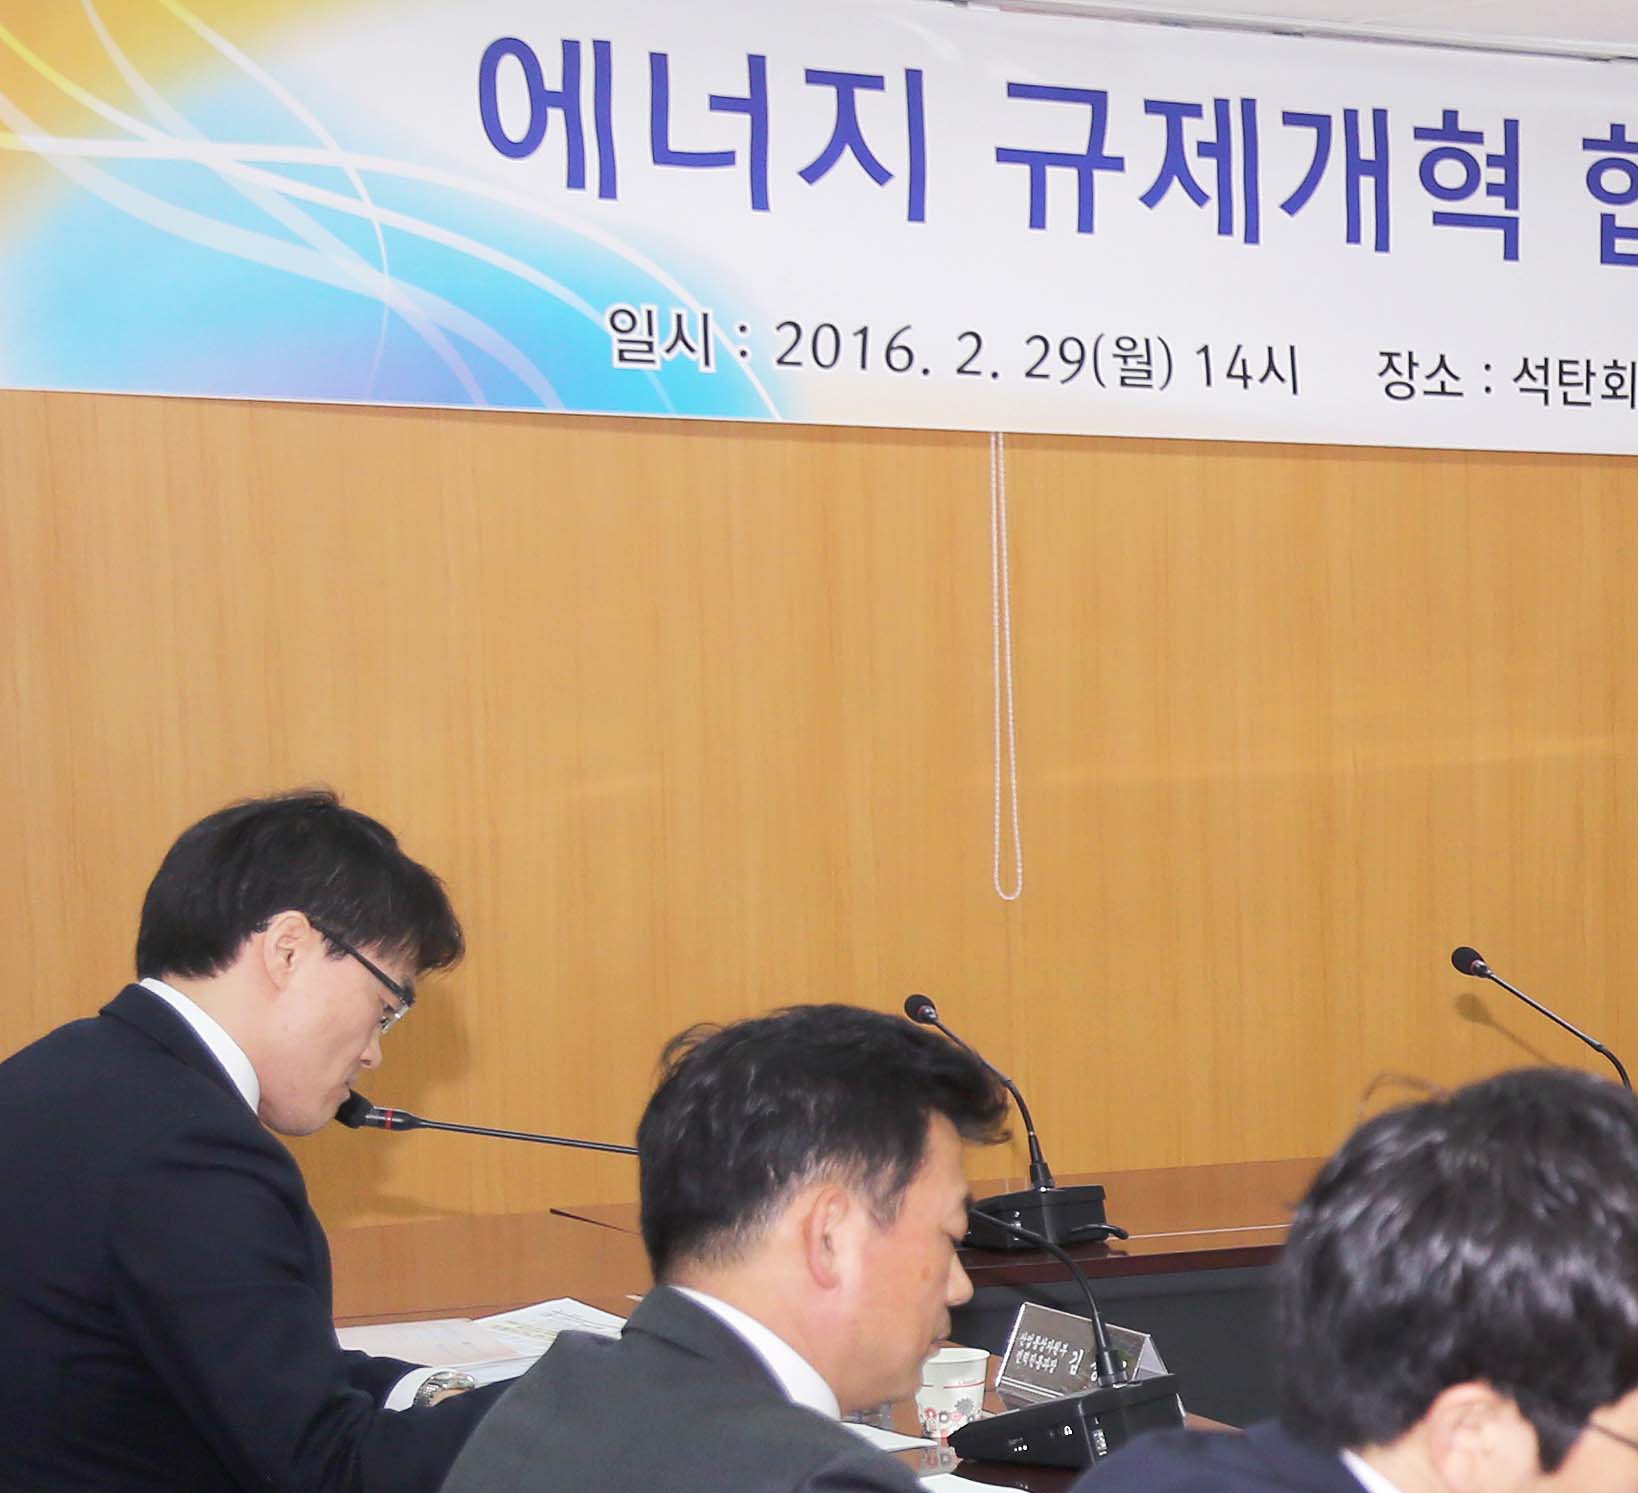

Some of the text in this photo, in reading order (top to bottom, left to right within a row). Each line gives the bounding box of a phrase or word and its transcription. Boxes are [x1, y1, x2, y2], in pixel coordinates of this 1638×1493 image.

[477, 36, 927, 223] 에너지
[994, 80, 1521, 263] 규제개혁
[608, 306, 712, 369] 일시
[775, 320, 931, 376] 2016.
[955, 330, 1000, 380] 2.
[1023, 332, 1174, 392] 29(월)
[1195, 343, 1299, 397] 14시
[1377, 350, 1465, 402] 장소
